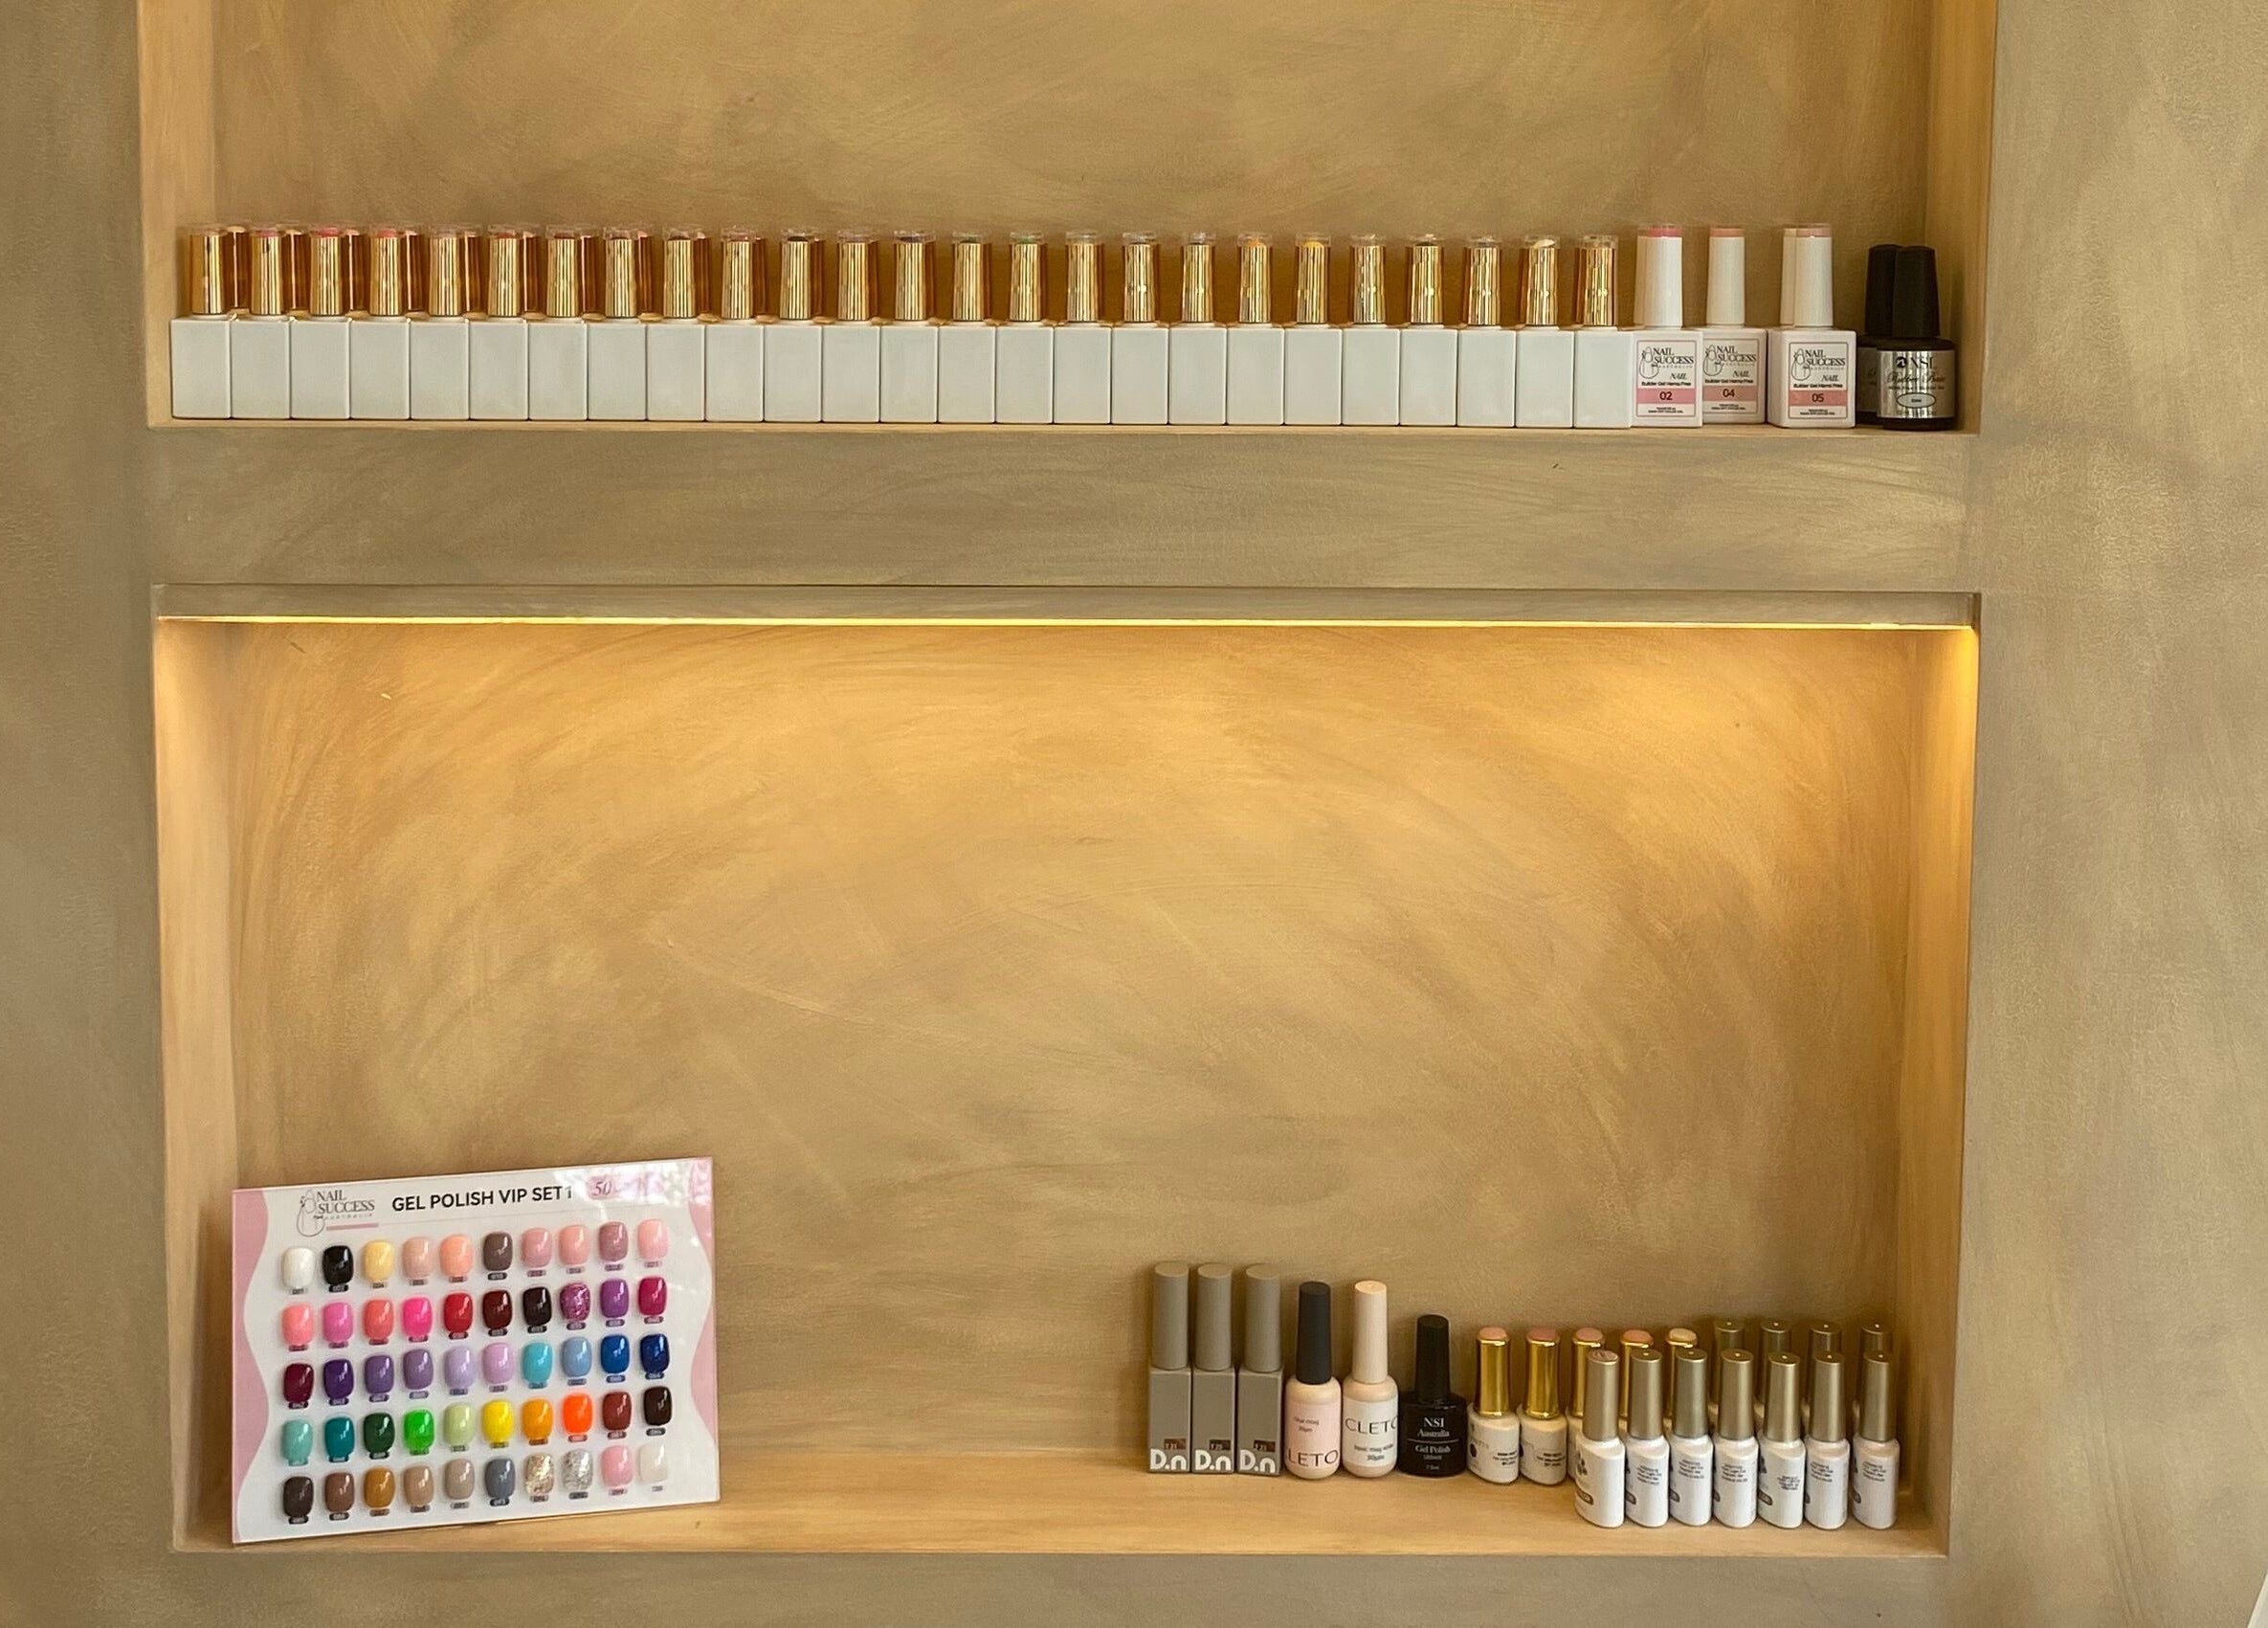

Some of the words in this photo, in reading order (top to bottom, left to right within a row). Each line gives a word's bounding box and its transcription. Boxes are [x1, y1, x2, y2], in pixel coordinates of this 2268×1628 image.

[1659, 391, 1673, 400] 02
[1723, 389, 1735, 397] 04
[1812, 393, 1825, 402] 05
[593, 1180, 612, 1195] 50
[317, 1190, 346, 1202] NAIL
[392, 1195, 426, 1212] GEL
[430, 1191, 494, 1210] POLISH
[499, 1188, 527, 1204] VIP
[531, 1186, 563, 1202] SET
[565, 1187, 572, 1198] 1
[319, 1200, 375, 1215] SUCCESS
[1423, 1417, 1444, 1427] NSI
